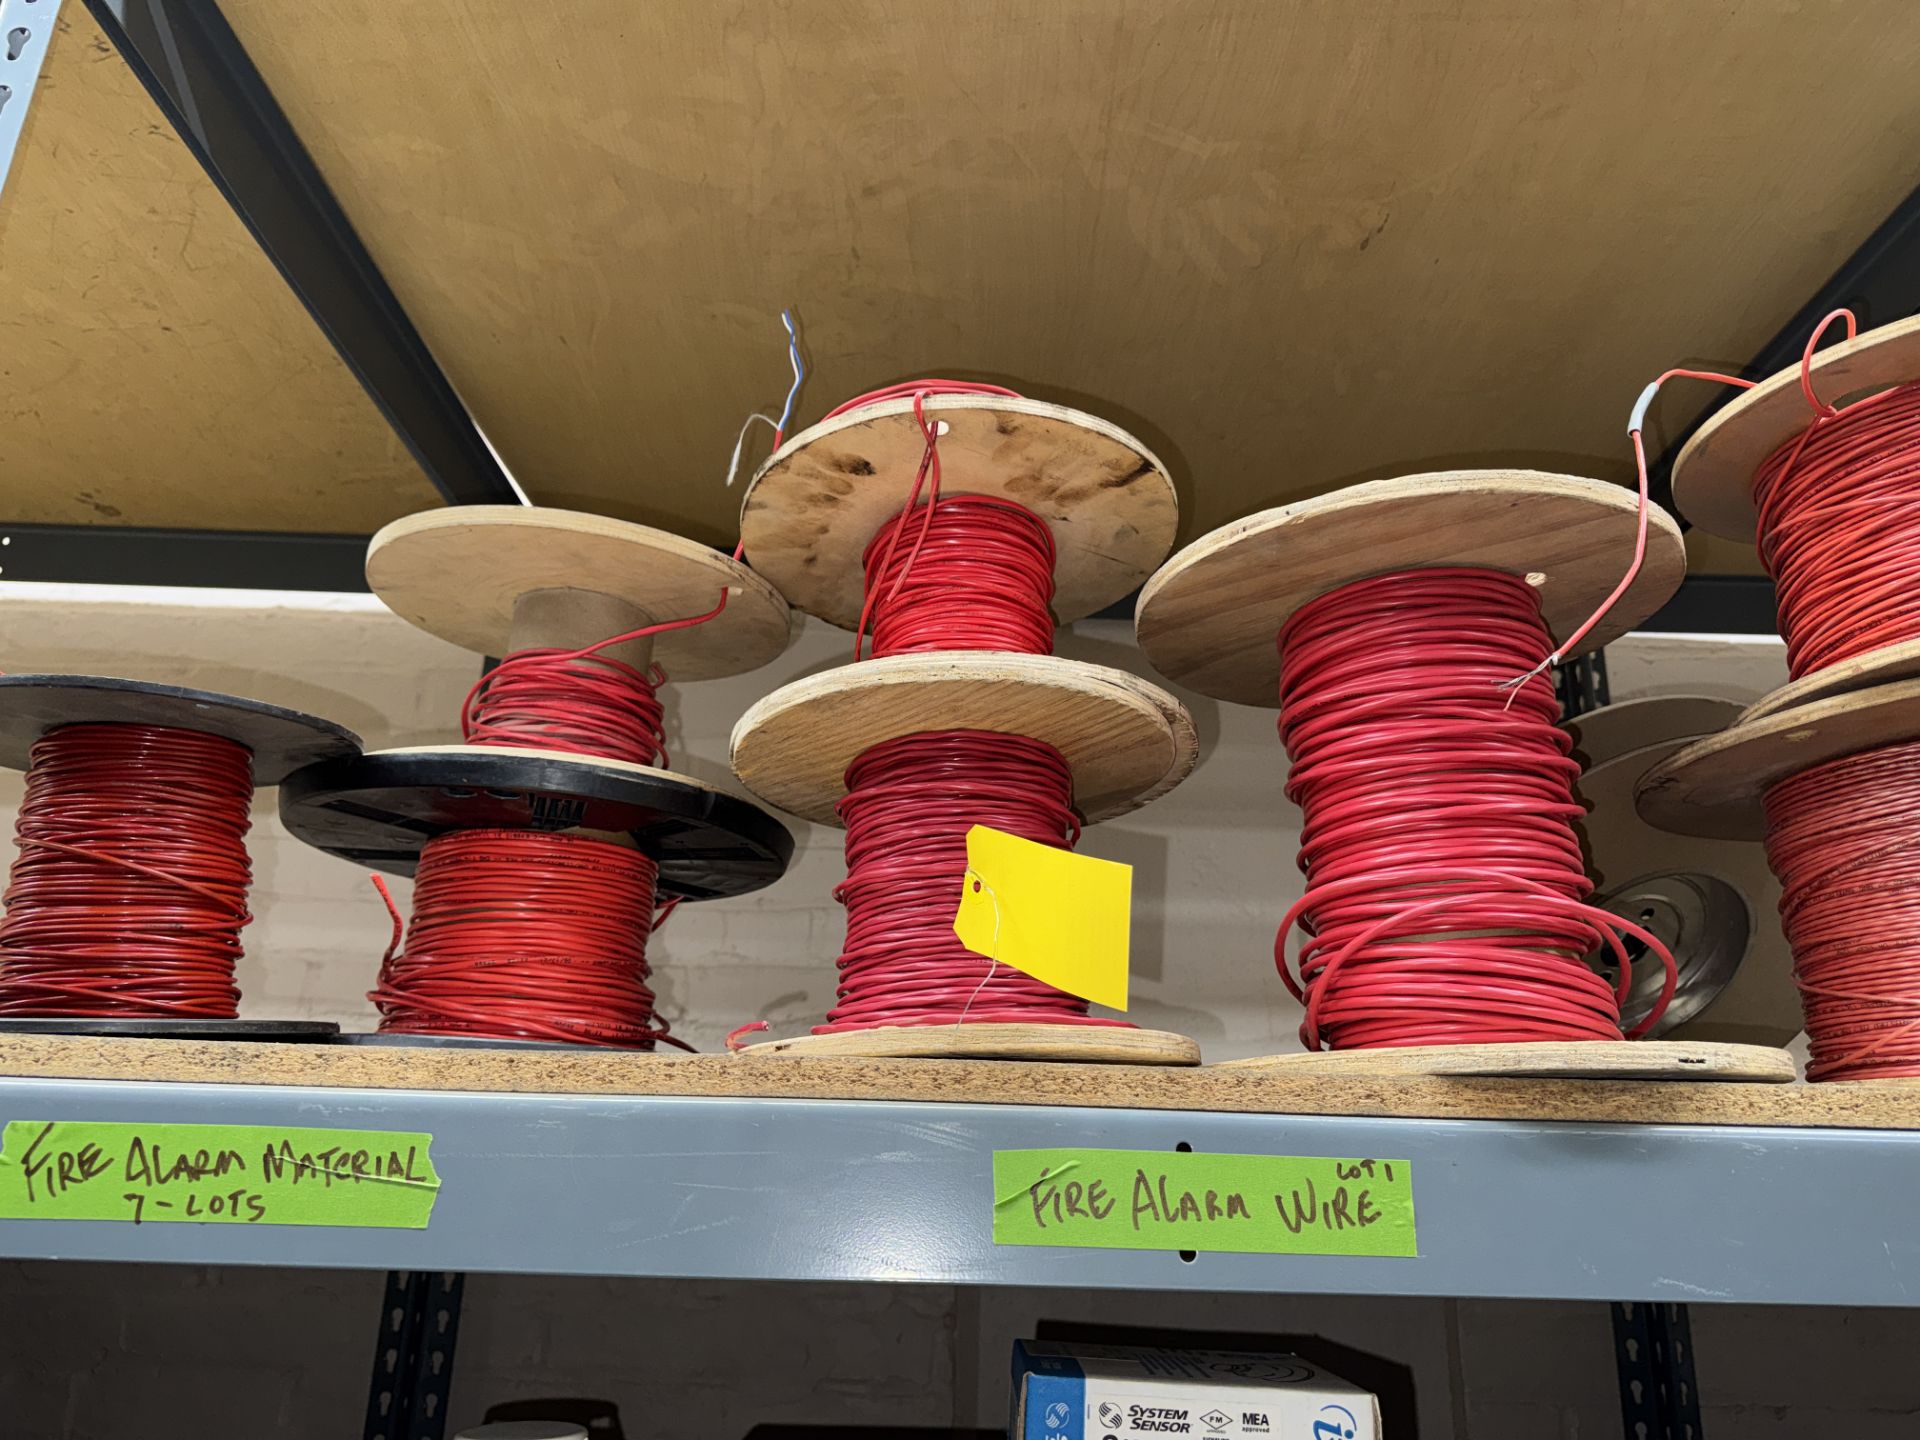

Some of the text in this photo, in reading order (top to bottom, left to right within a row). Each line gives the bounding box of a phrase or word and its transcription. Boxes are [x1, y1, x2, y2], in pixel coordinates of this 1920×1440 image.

[21, 1122, 428, 1202] FIRE ALARM MATERIAL
[1336, 1159, 1376, 1181] LOT
[1029, 1167, 1384, 1234] FIRE ALARM WIRE
[1127, 1405, 1189, 1420] SYSTEM
[1209, 1416, 1223, 1424] FM
[1242, 1412, 1270, 1426] MEA
[1130, 1417, 1191, 1434] SENSOR
